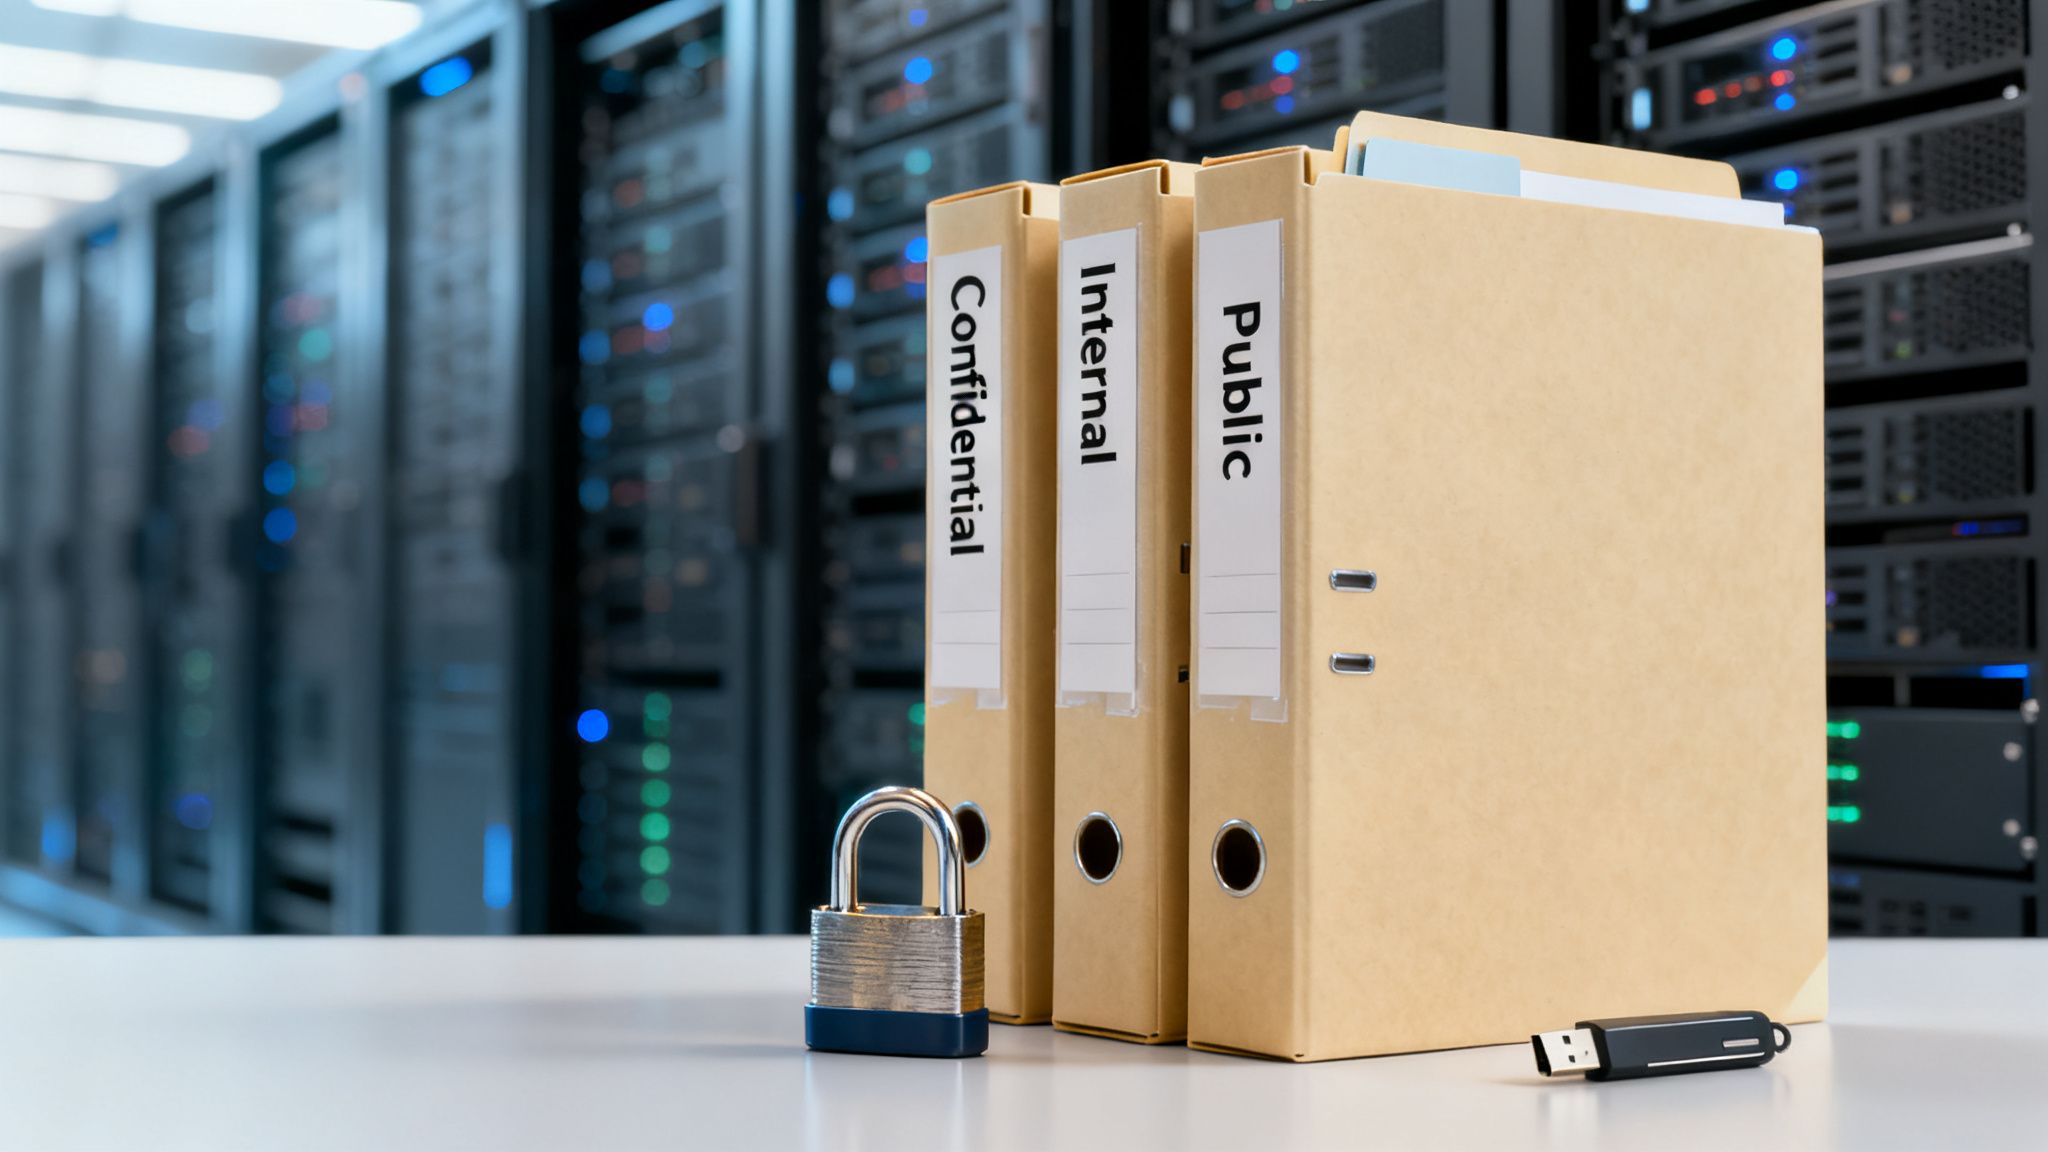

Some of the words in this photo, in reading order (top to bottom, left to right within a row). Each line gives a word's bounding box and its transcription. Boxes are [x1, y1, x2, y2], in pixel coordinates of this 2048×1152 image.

[949, 275, 987, 556] Confidential
[1080, 262, 1117, 465] Internal
[1222, 301, 1264, 481] Public
